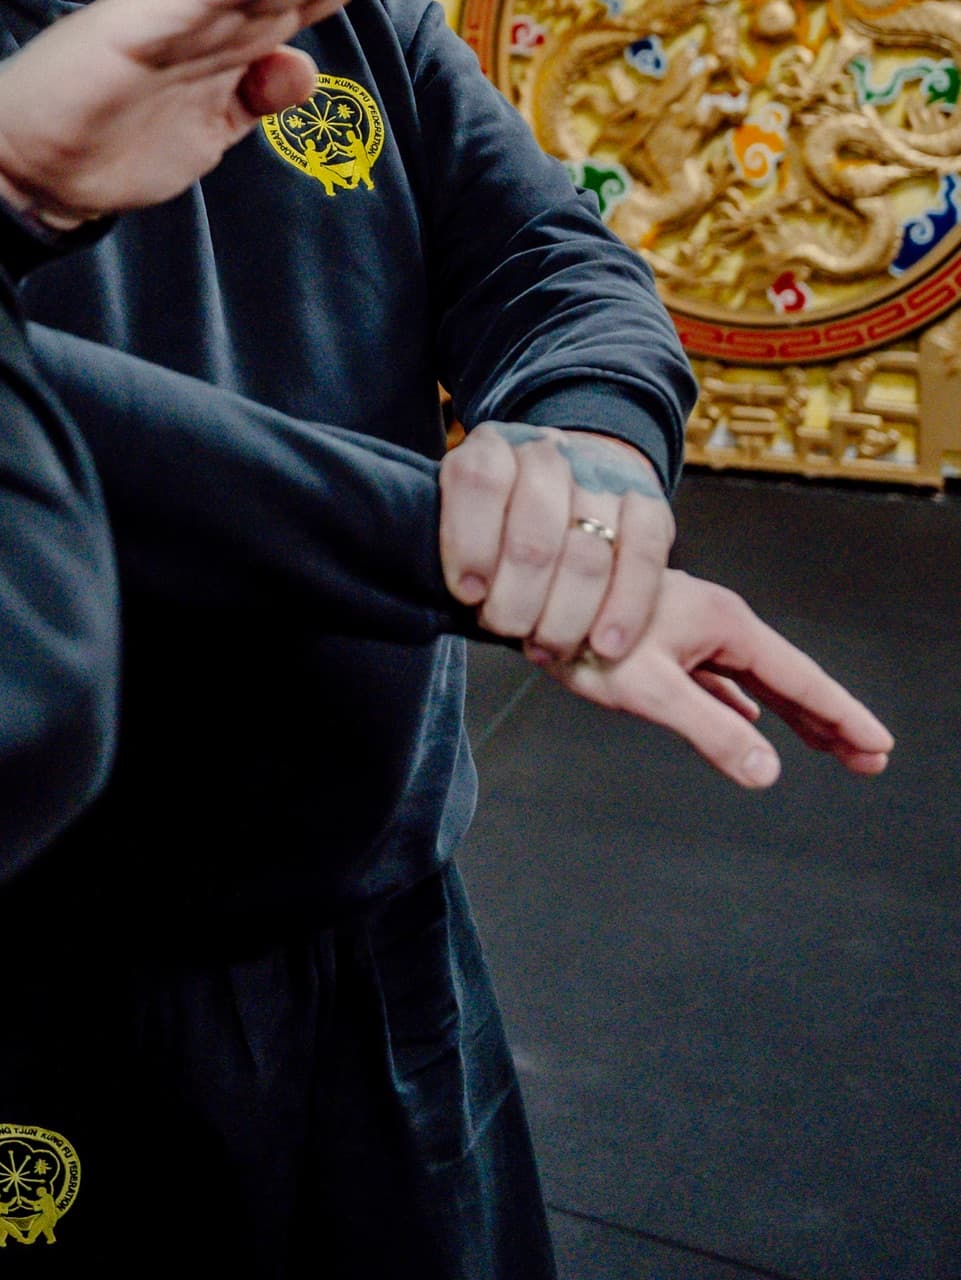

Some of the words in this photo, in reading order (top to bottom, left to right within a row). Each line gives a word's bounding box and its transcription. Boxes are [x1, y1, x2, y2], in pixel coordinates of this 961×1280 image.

[270, 130, 308, 168] EUROPEAN
[334, 79, 359, 92] KUNG
[359, 91, 370, 102] FU
[368, 105, 382, 157] FEDERATION
[14, 1127, 38, 1137] TJUN
[41, 1133, 63, 1147] KUNG
[62, 1146, 73, 1159] FU
[57, 1160, 78, 1212] FEDERATION
